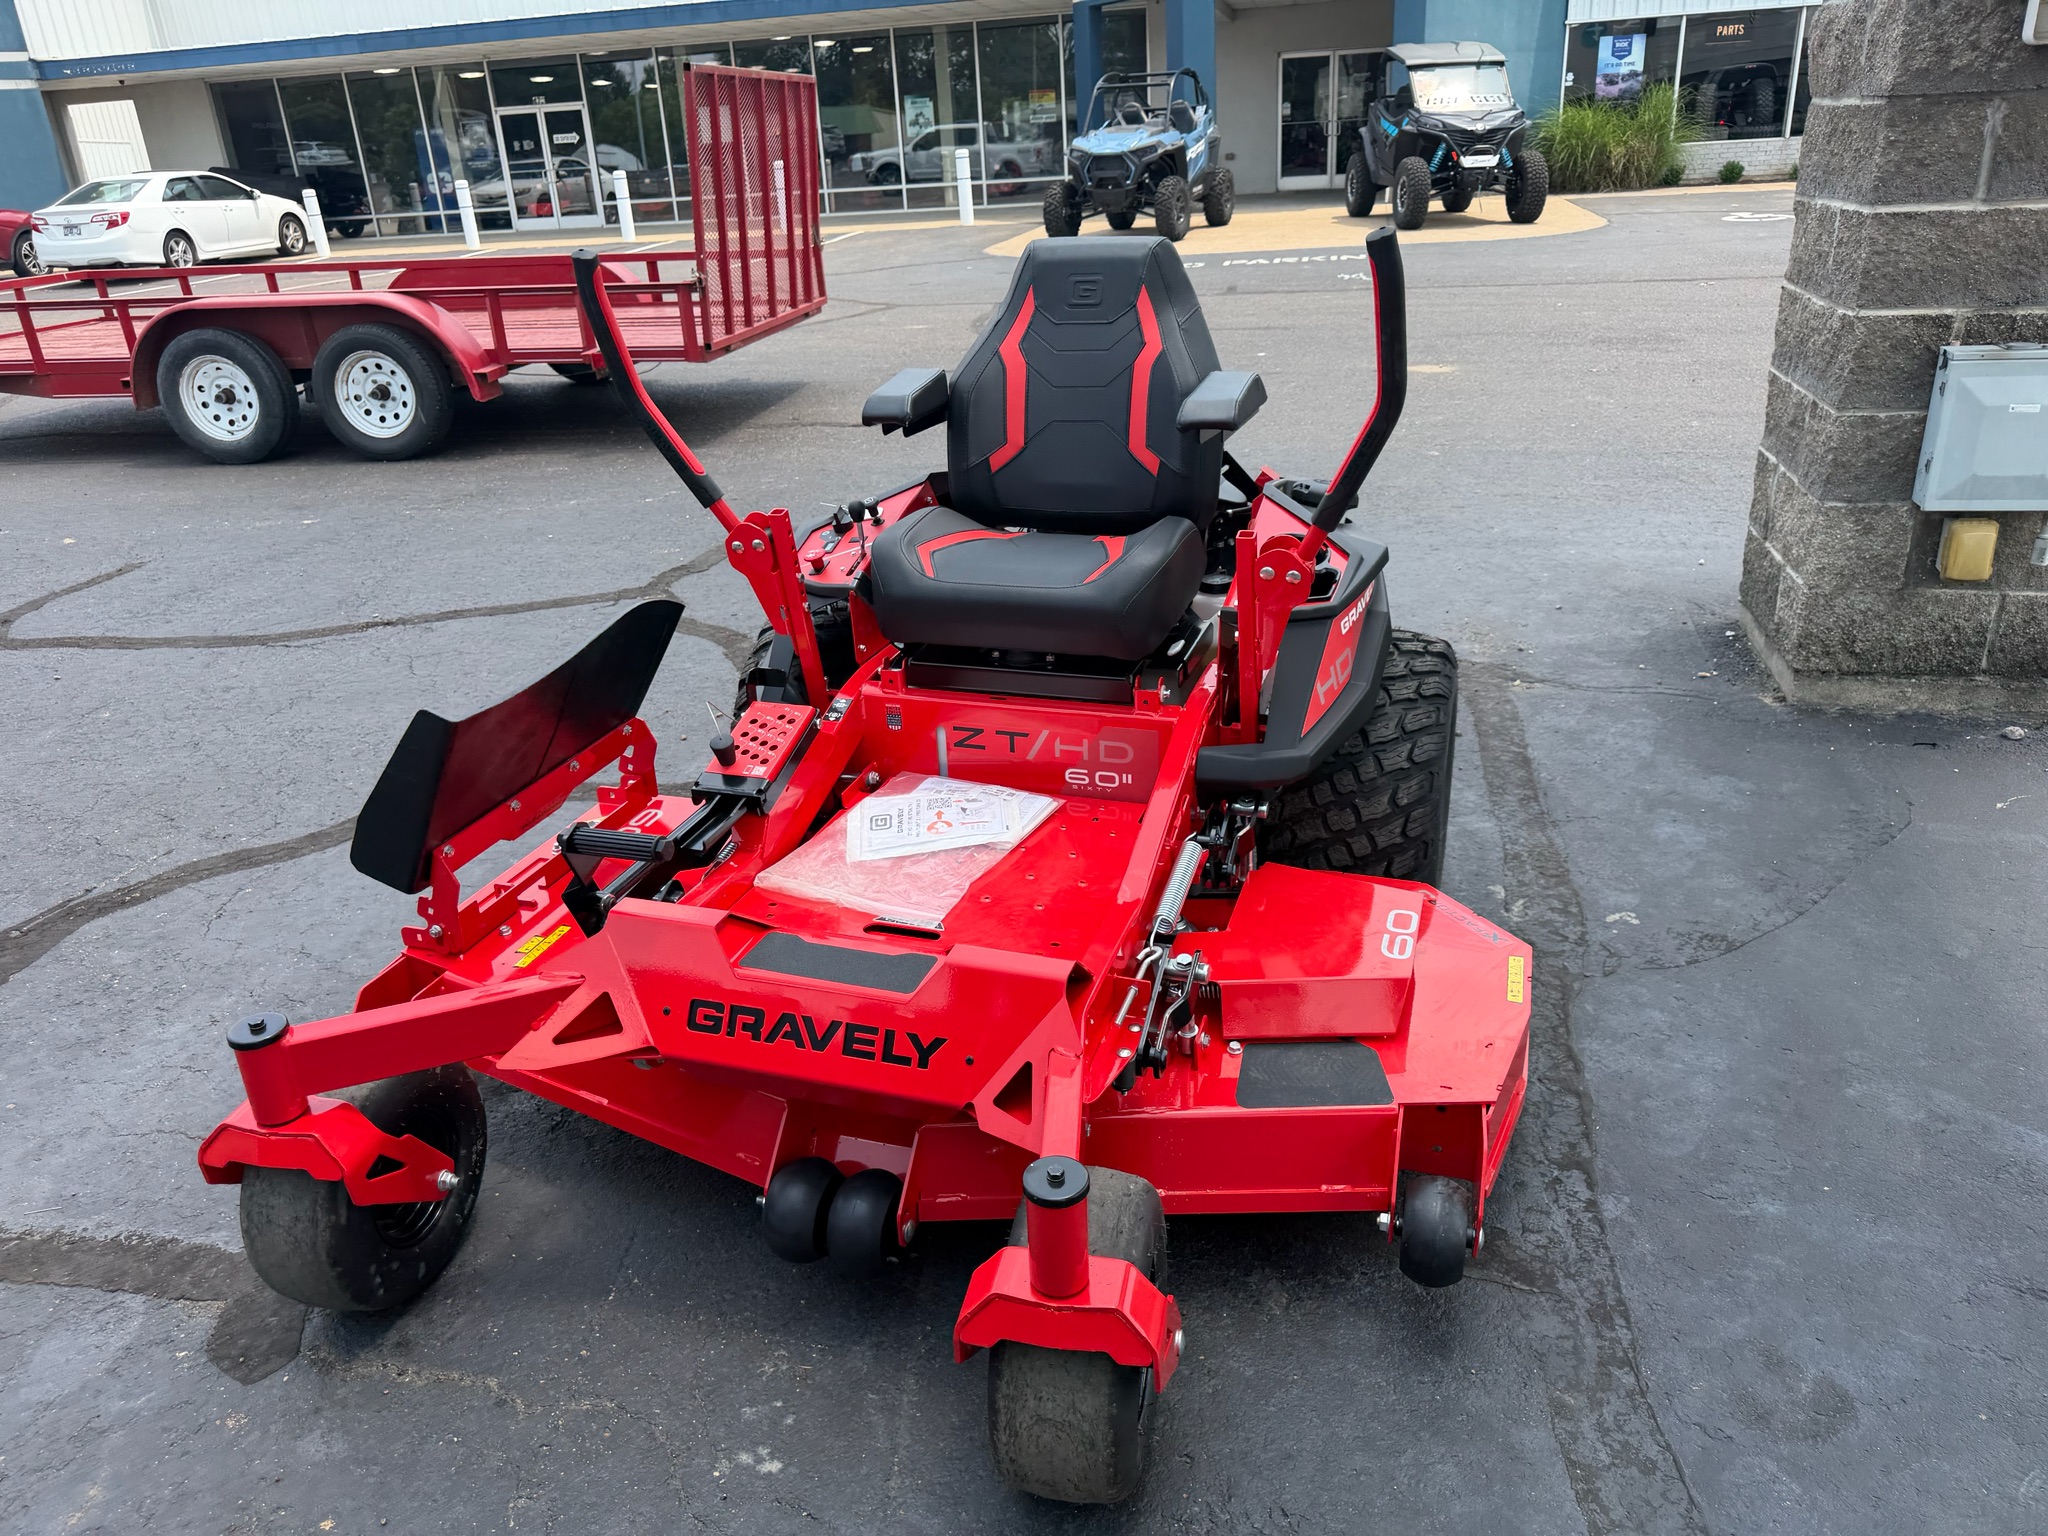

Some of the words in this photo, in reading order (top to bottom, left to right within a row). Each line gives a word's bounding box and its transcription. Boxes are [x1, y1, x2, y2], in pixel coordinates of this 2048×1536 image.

[1716, 24, 1745, 36] PARTS
[1222, 254, 1368, 267] PARKIN
[1317, 647, 1352, 705] HD
[1072, 784, 1113, 793] SIXTY
[1381, 909, 1419, 960] 60
[687, 998, 949, 1070] GRAVELY
